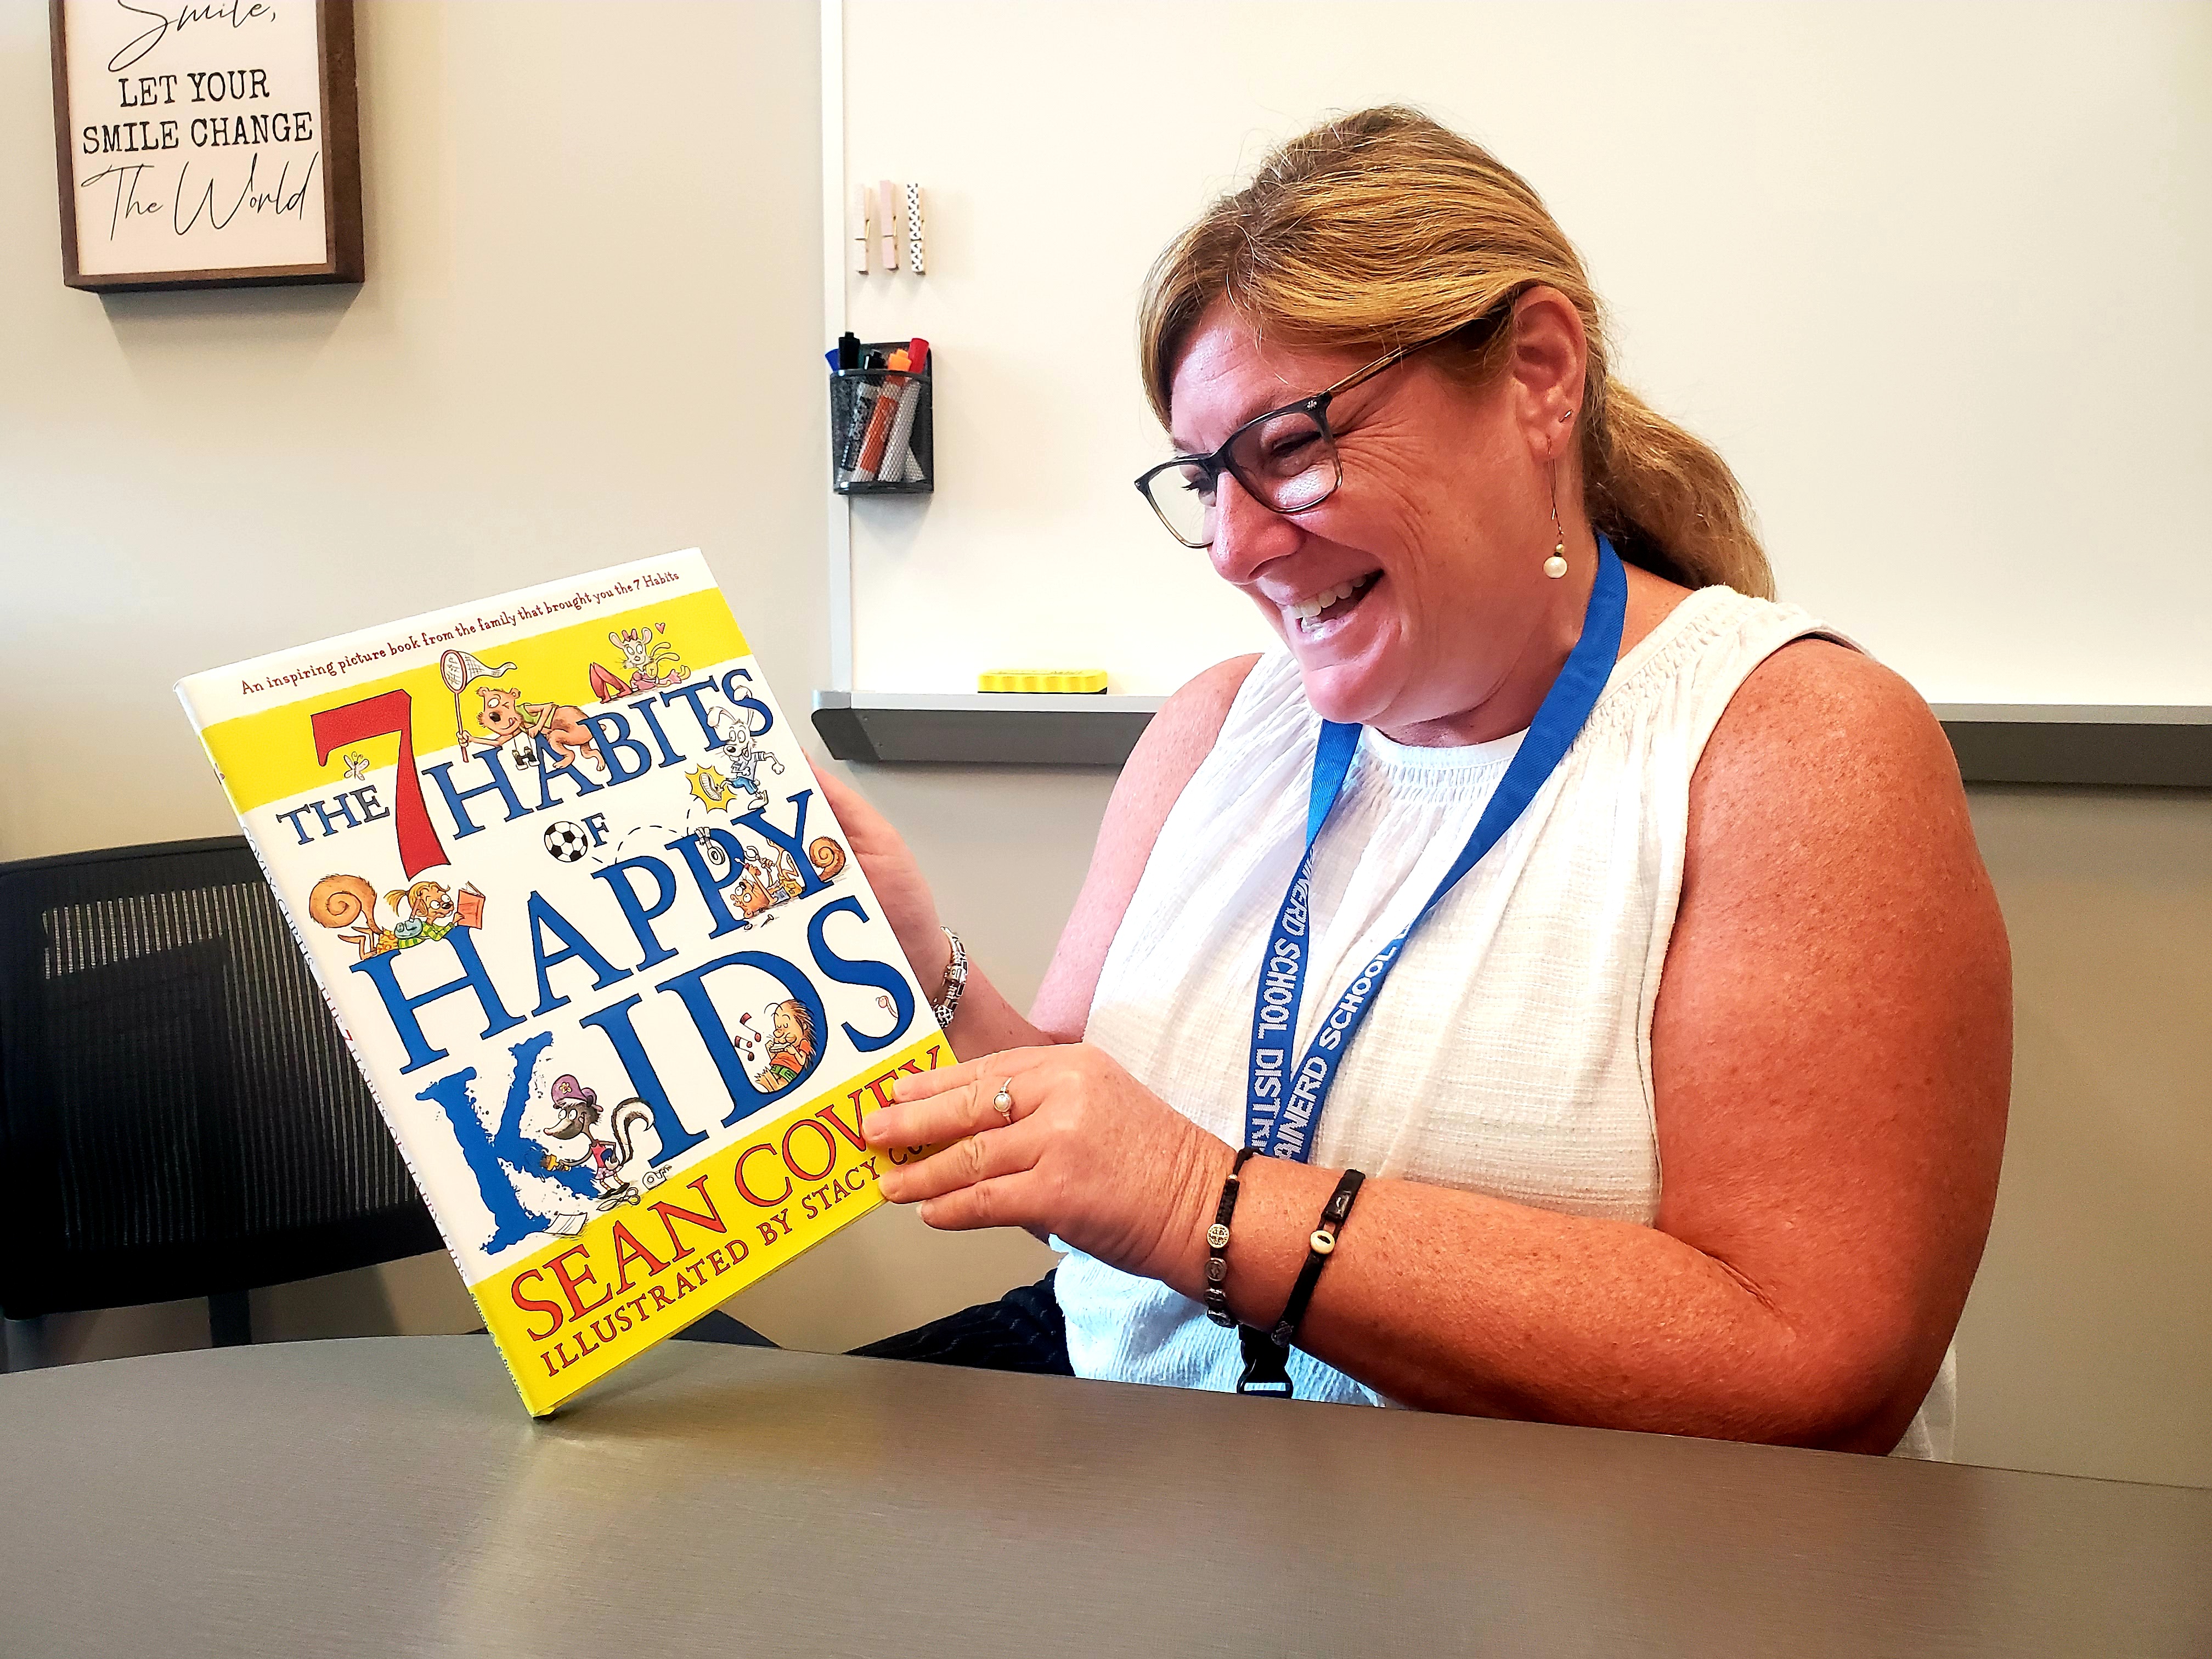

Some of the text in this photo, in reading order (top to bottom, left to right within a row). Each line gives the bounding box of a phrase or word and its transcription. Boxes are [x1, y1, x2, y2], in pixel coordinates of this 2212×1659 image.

[82, 111, 313, 155] SMILE CHANGE
[119, 69, 270, 108] LET YOUR
[81, 151, 319, 241] The World
[242, 571, 680, 695] An inspiring picture book from the family that brought you the 7 Habits
[276, 668, 774, 882] THE 7 HABITS
[349, 789, 835, 1076] HAPPY
[1257, 937, 1301, 1040] SCHOOL
[1319, 945, 1397, 1051] SCHOOL
[415, 895, 916, 1255] KIDS
[1251, 1048, 1284, 1153] DISTRI
[510, 1173, 727, 1342] SEAN
[540, 1156, 881, 1377] ILLUSTRATED BY STACY
